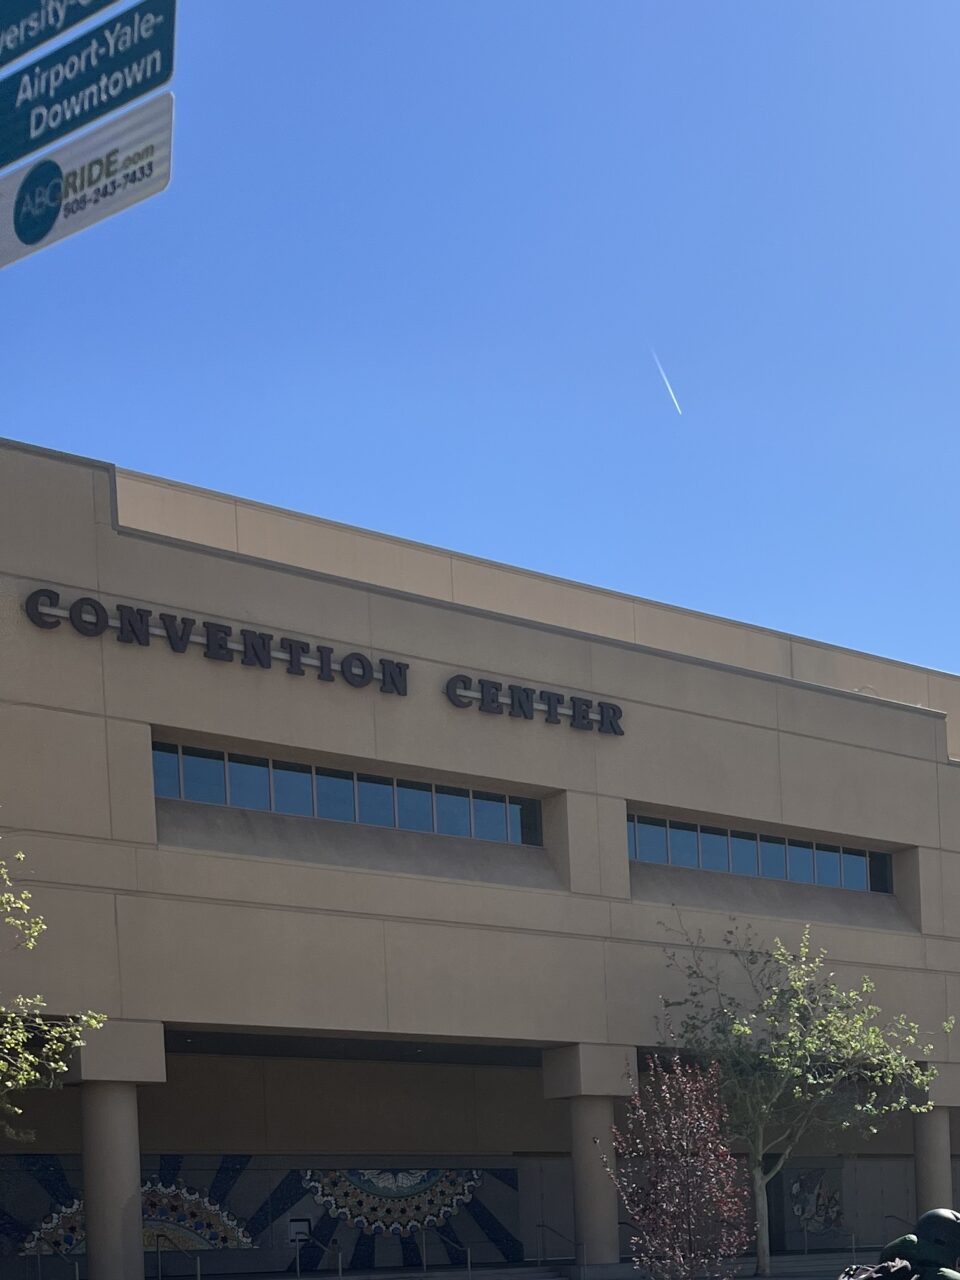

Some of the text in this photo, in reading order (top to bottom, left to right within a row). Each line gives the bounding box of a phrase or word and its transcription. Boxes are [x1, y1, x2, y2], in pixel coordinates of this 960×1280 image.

[16, 12, 164, 108] Airport-Yale-
[29, 49, 162, 139] Downtown
[25, 588, 625, 736] CONVENTION CENTER
